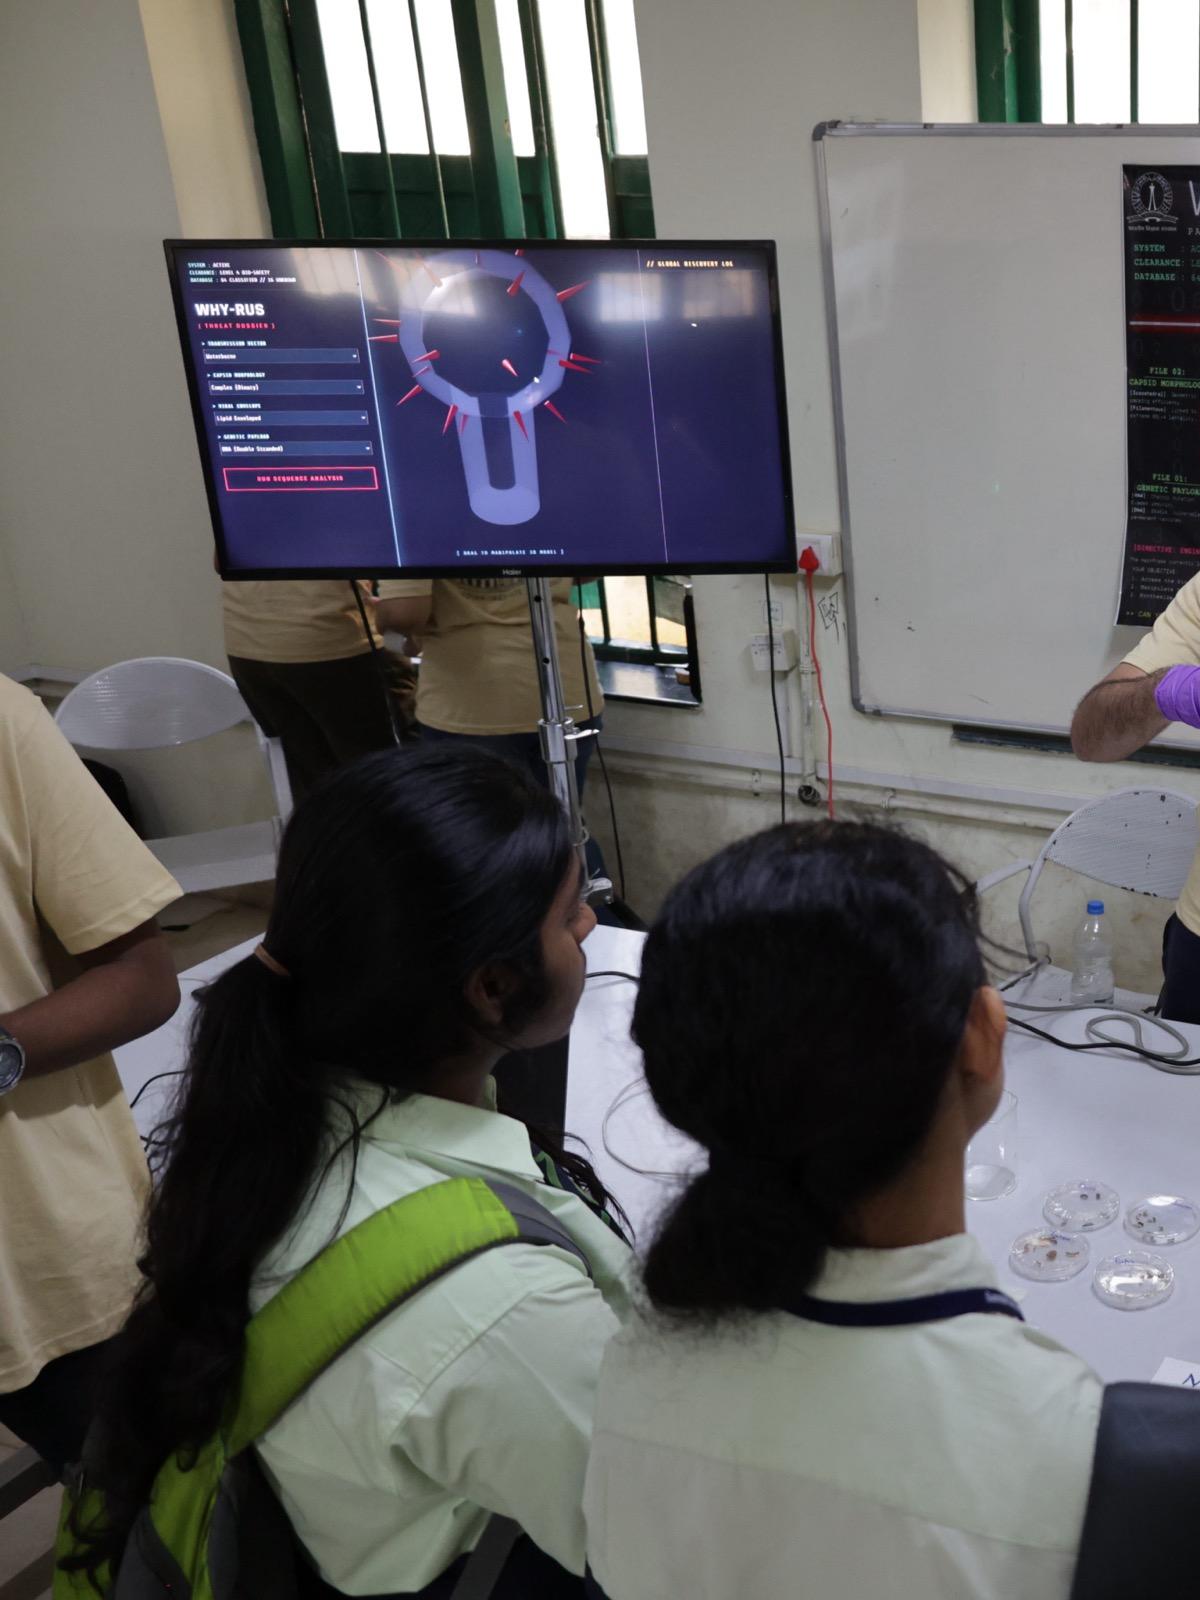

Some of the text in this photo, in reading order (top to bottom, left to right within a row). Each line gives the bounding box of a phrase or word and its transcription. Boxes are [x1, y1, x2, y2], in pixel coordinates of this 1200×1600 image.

[1134, 244, 1166, 252] SYSTEM
[1134, 272, 1176, 281] DATABASE
[194, 303, 265, 316] WHY-RUS
[1150, 367, 1168, 375] FILE
